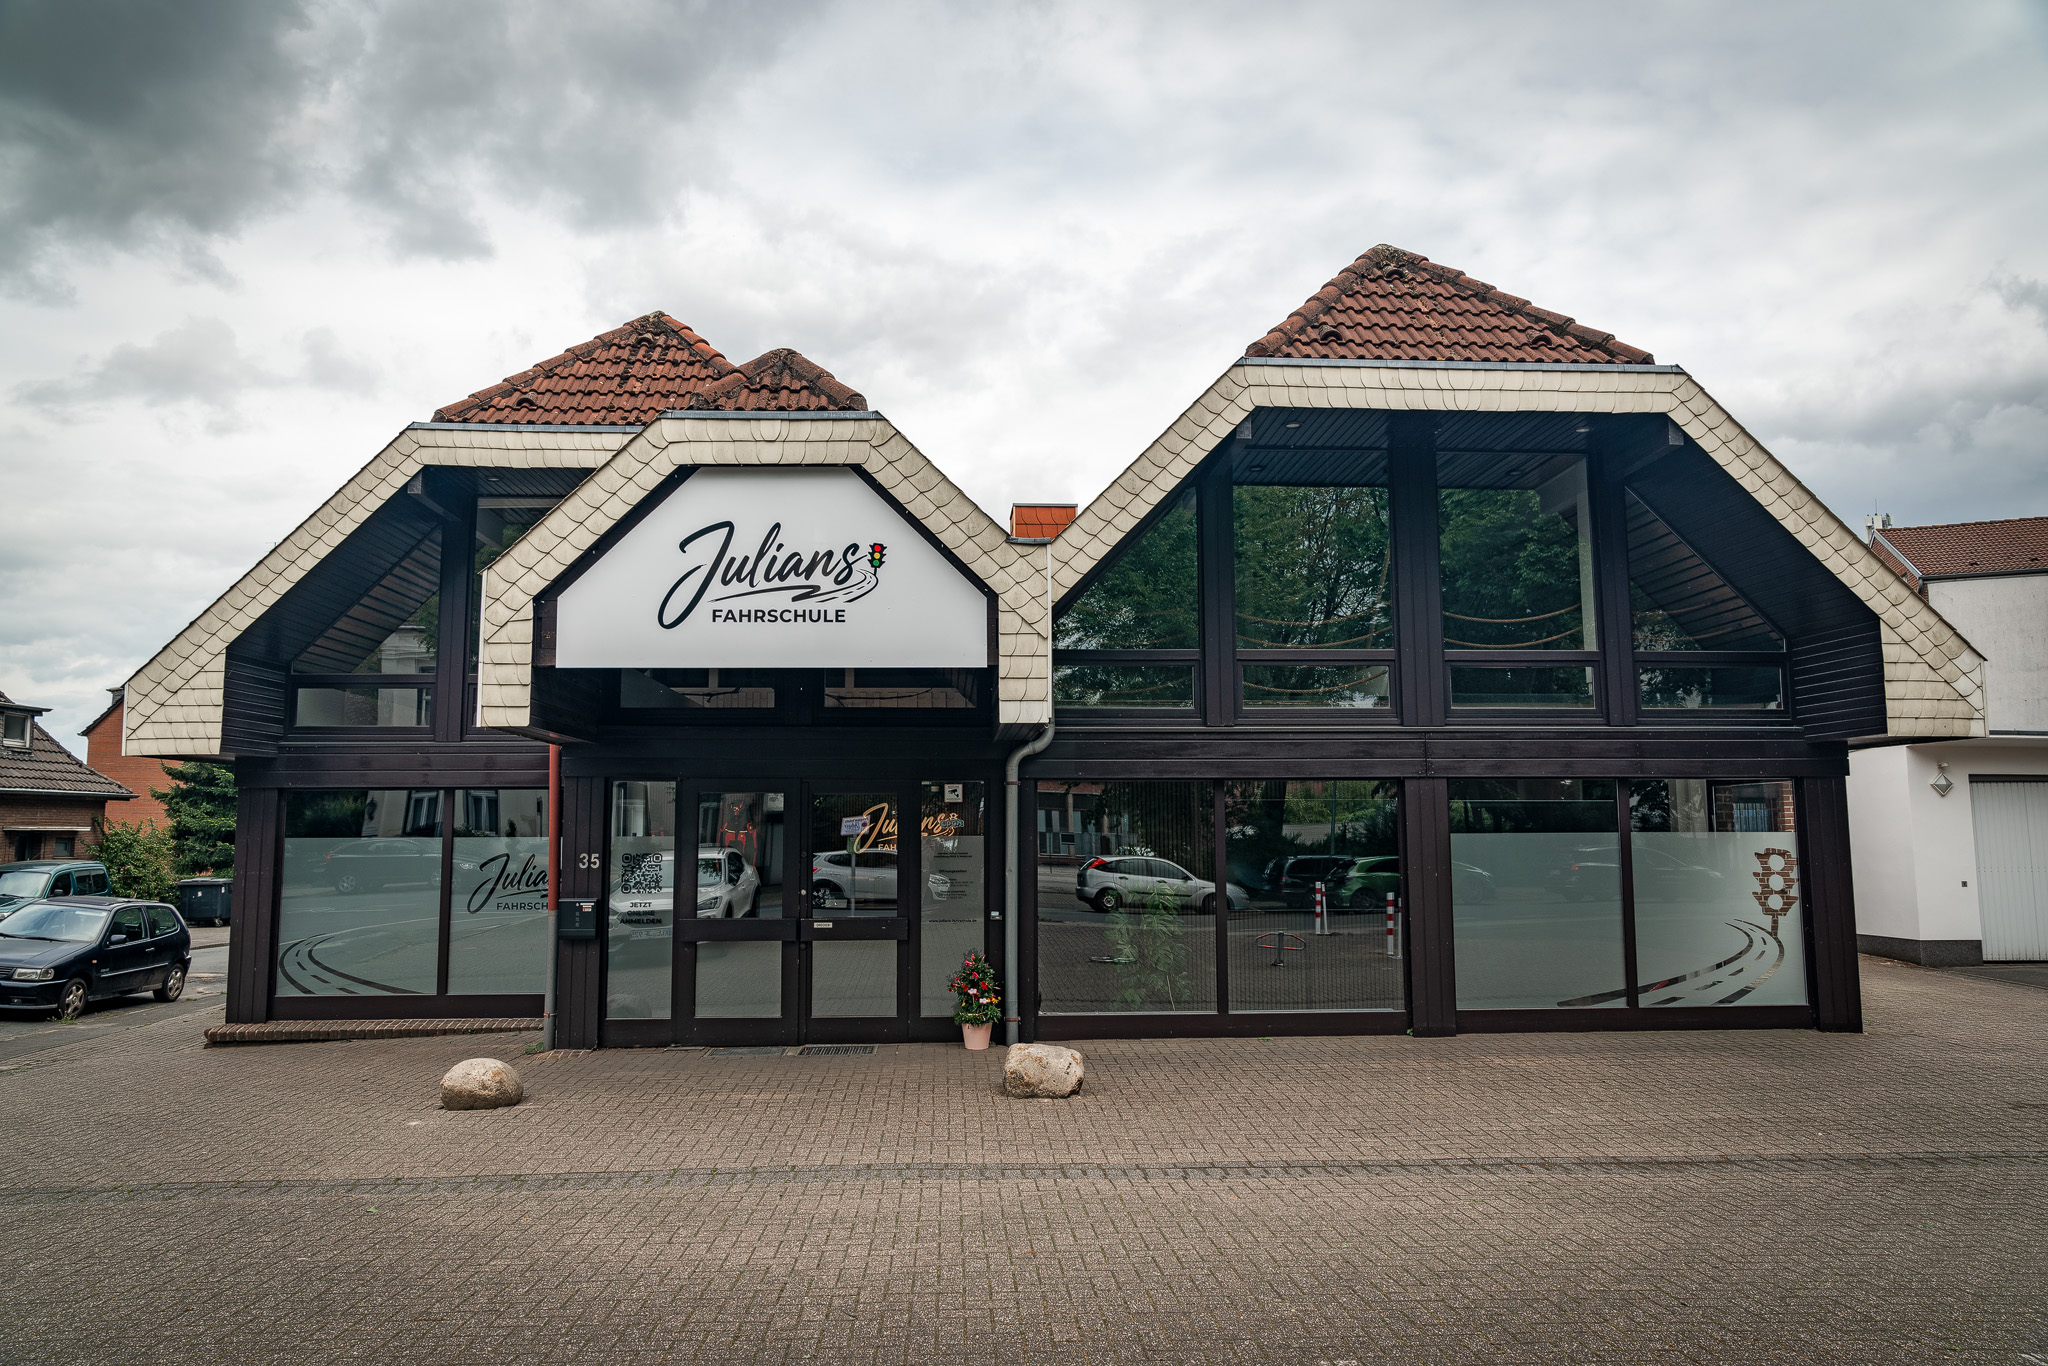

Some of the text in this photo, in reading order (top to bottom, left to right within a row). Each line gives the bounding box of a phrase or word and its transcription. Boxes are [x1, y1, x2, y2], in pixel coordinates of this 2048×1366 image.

[657, 520, 863, 630] Julians
[711, 608, 846, 624] FAHRSCHULE
[578, 853, 600, 869] 35
